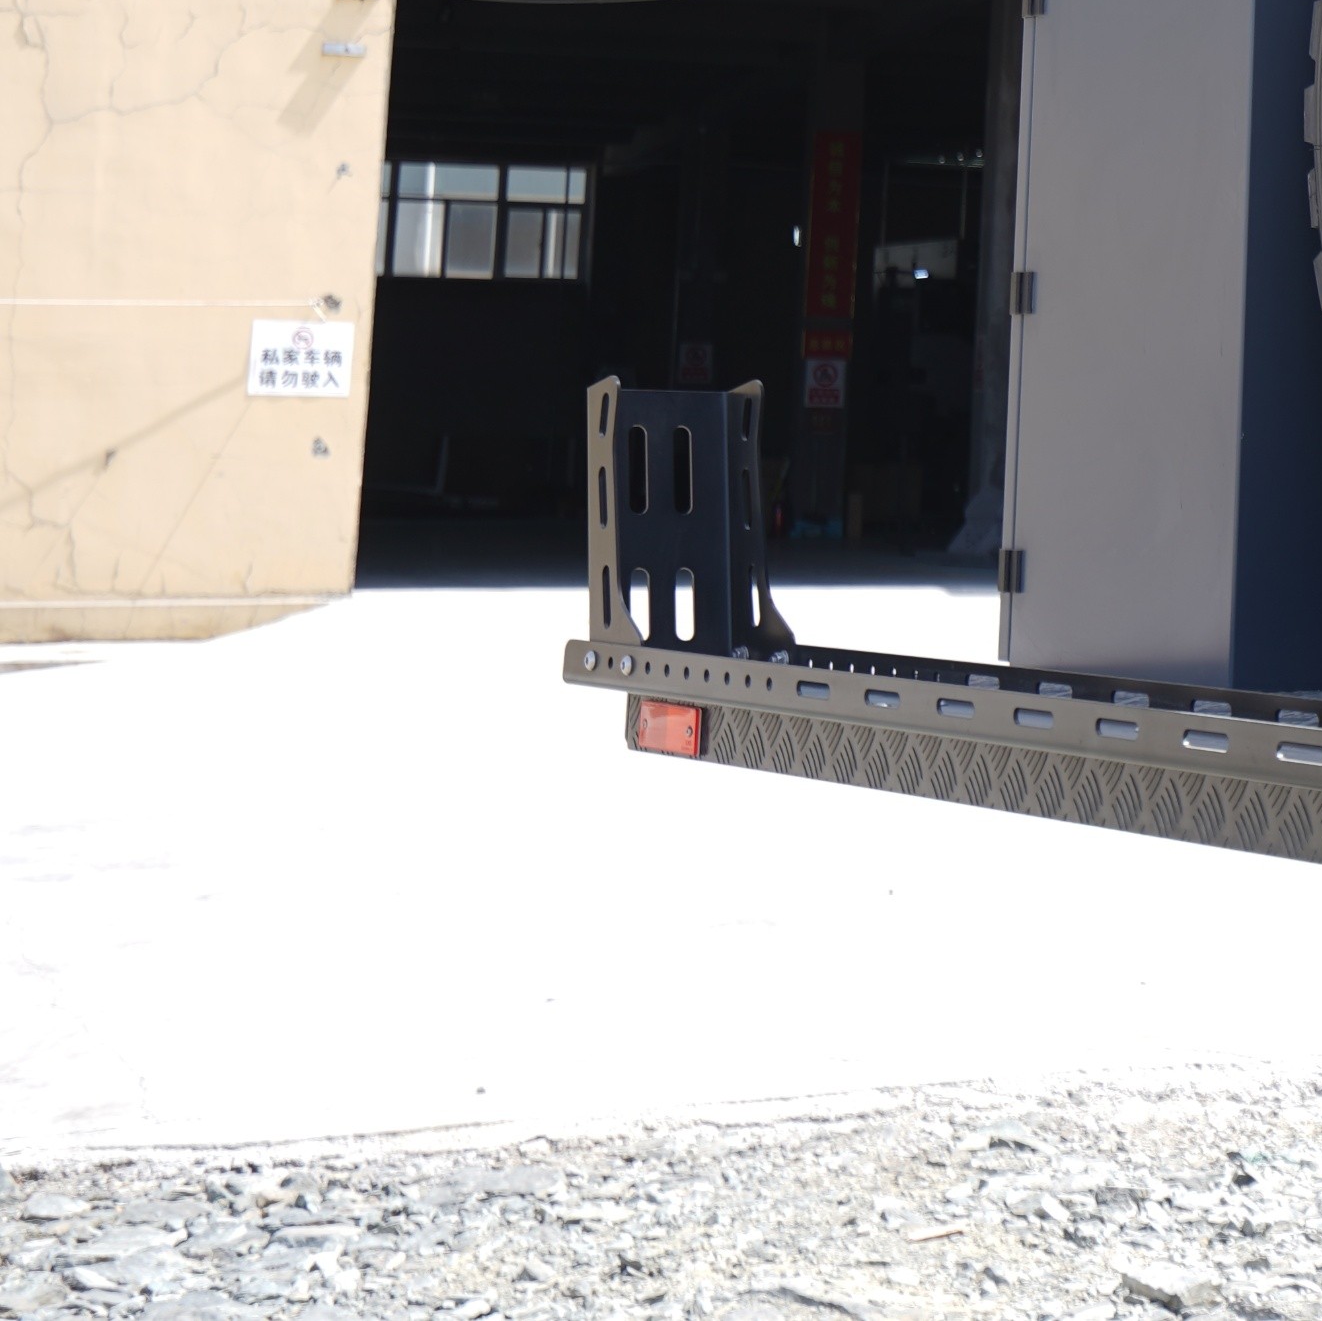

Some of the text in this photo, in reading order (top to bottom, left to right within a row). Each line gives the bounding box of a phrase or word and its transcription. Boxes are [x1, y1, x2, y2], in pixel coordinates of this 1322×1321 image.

[260, 348, 343, 367] 私家车辆
[258, 370, 340, 389] 请勿驶入
